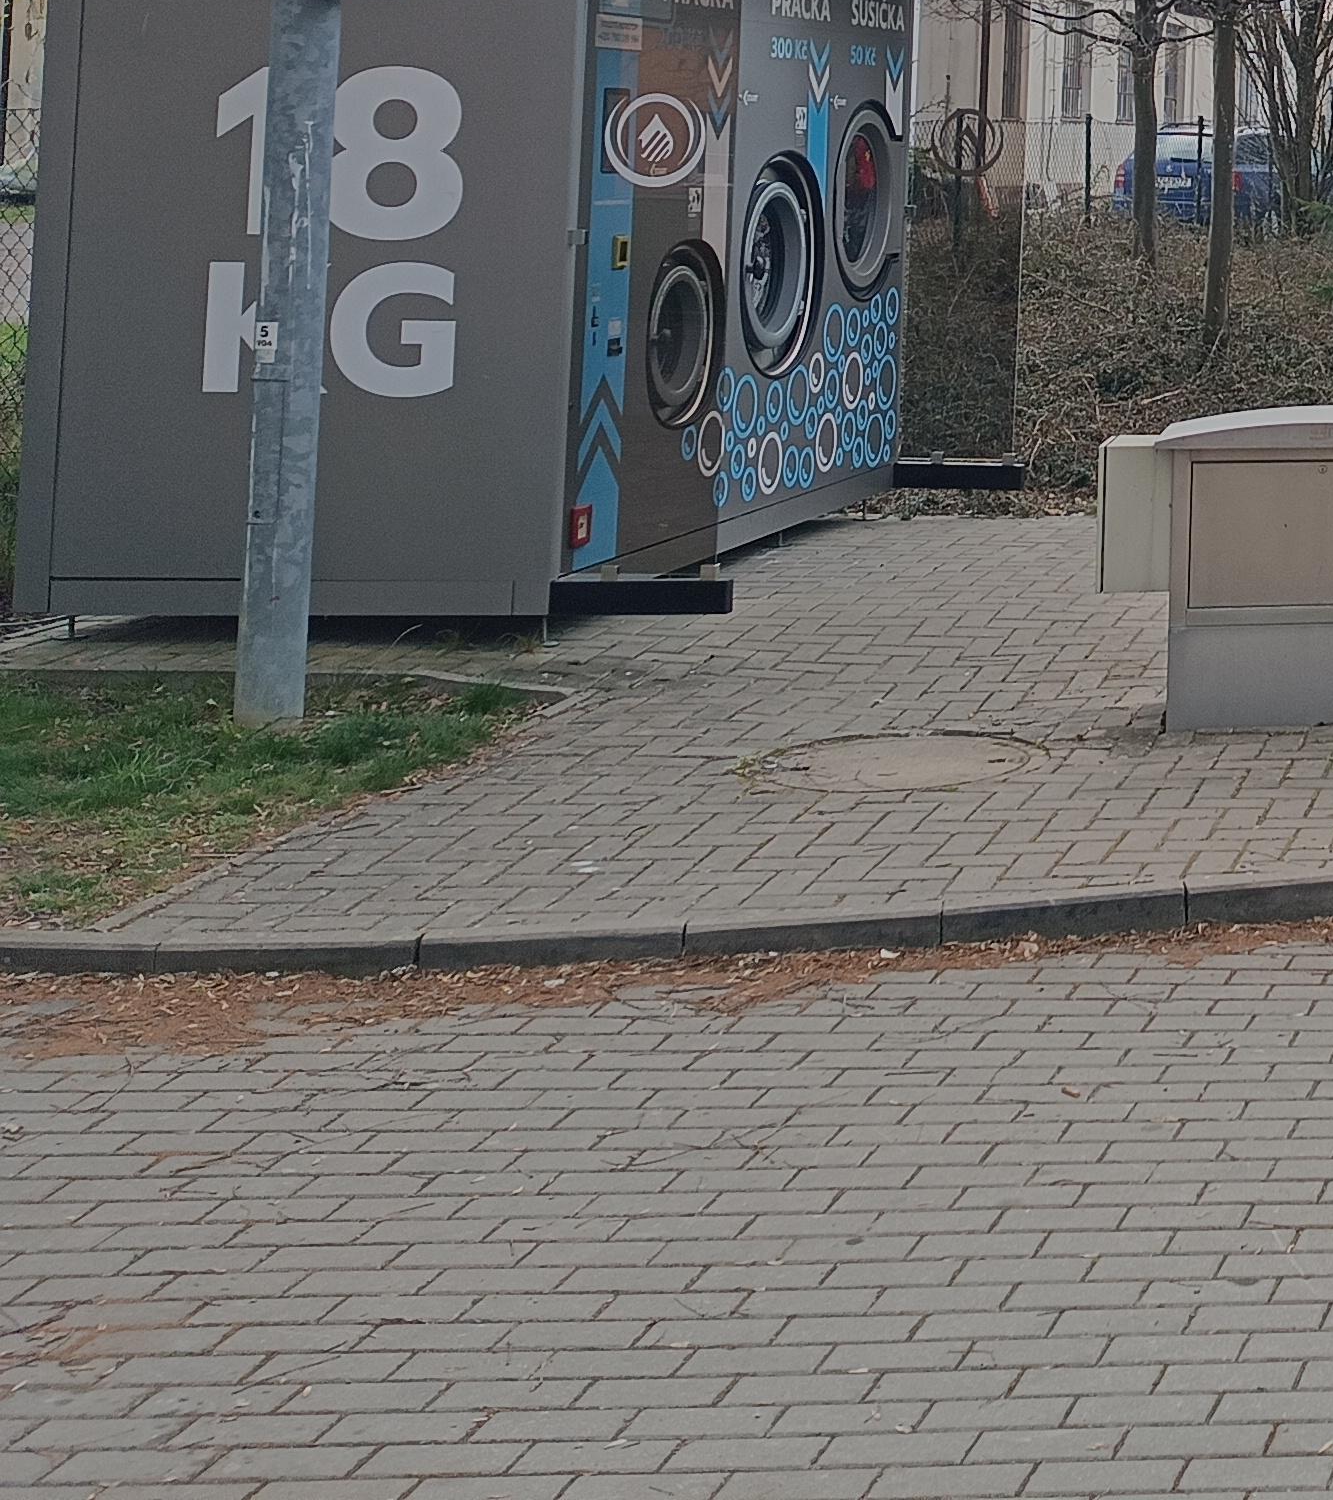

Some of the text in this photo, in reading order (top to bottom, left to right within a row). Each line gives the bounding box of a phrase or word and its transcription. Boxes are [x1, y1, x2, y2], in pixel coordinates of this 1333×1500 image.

[770, 37, 793, 59] 300
[850, 45, 864, 65] 50
[260, 325, 269, 338] 5
